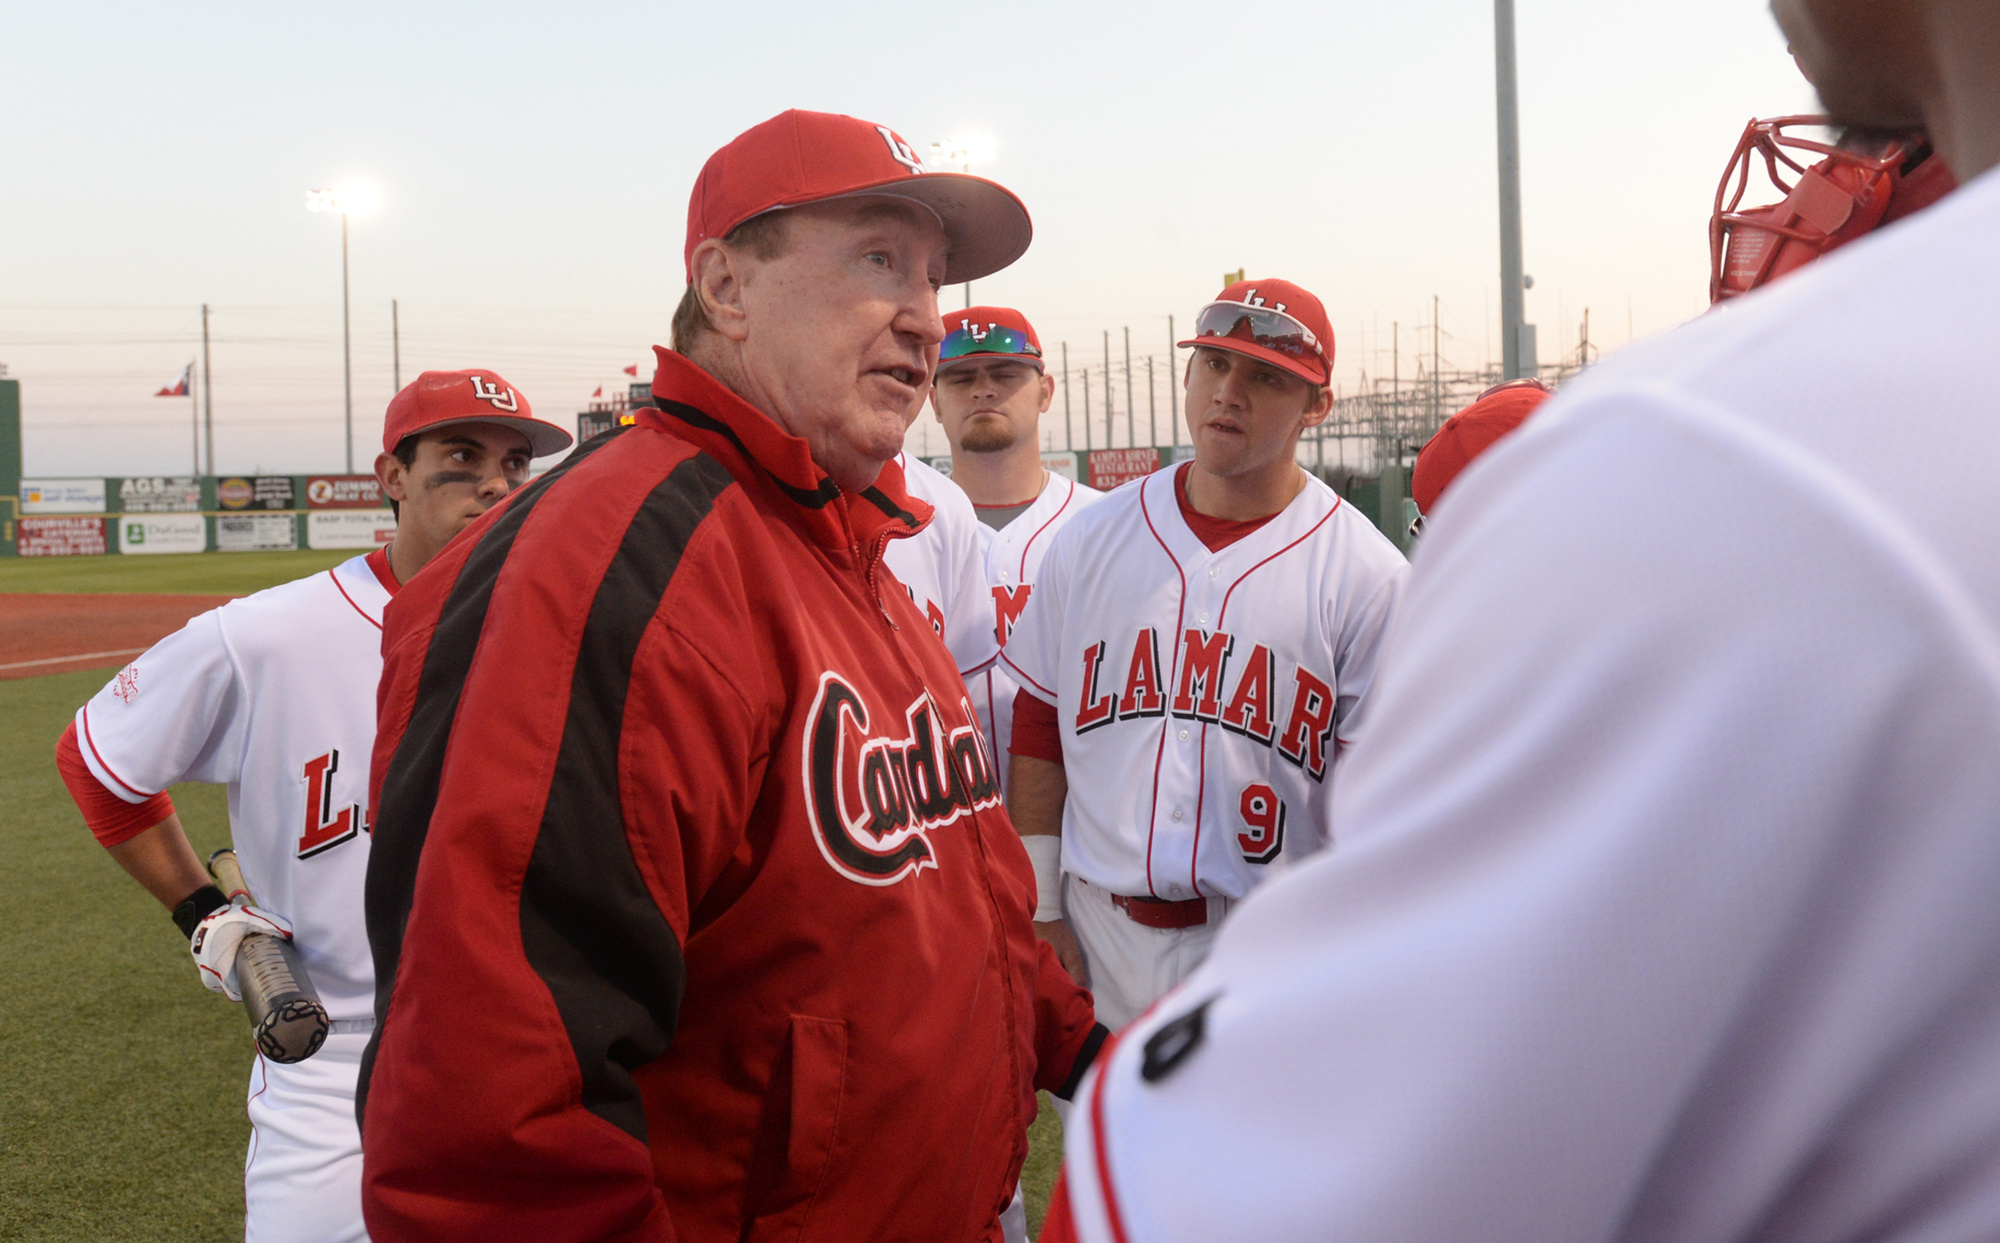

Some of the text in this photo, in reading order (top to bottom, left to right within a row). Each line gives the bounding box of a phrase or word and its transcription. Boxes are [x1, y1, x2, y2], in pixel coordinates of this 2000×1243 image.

[469, 375, 519, 413] LU
[1094, 460, 1152, 474] RESTAURANT
[1075, 625, 1337, 785] LAMAR
[296, 747, 370, 861] L
[1235, 780, 1287, 865] 9
